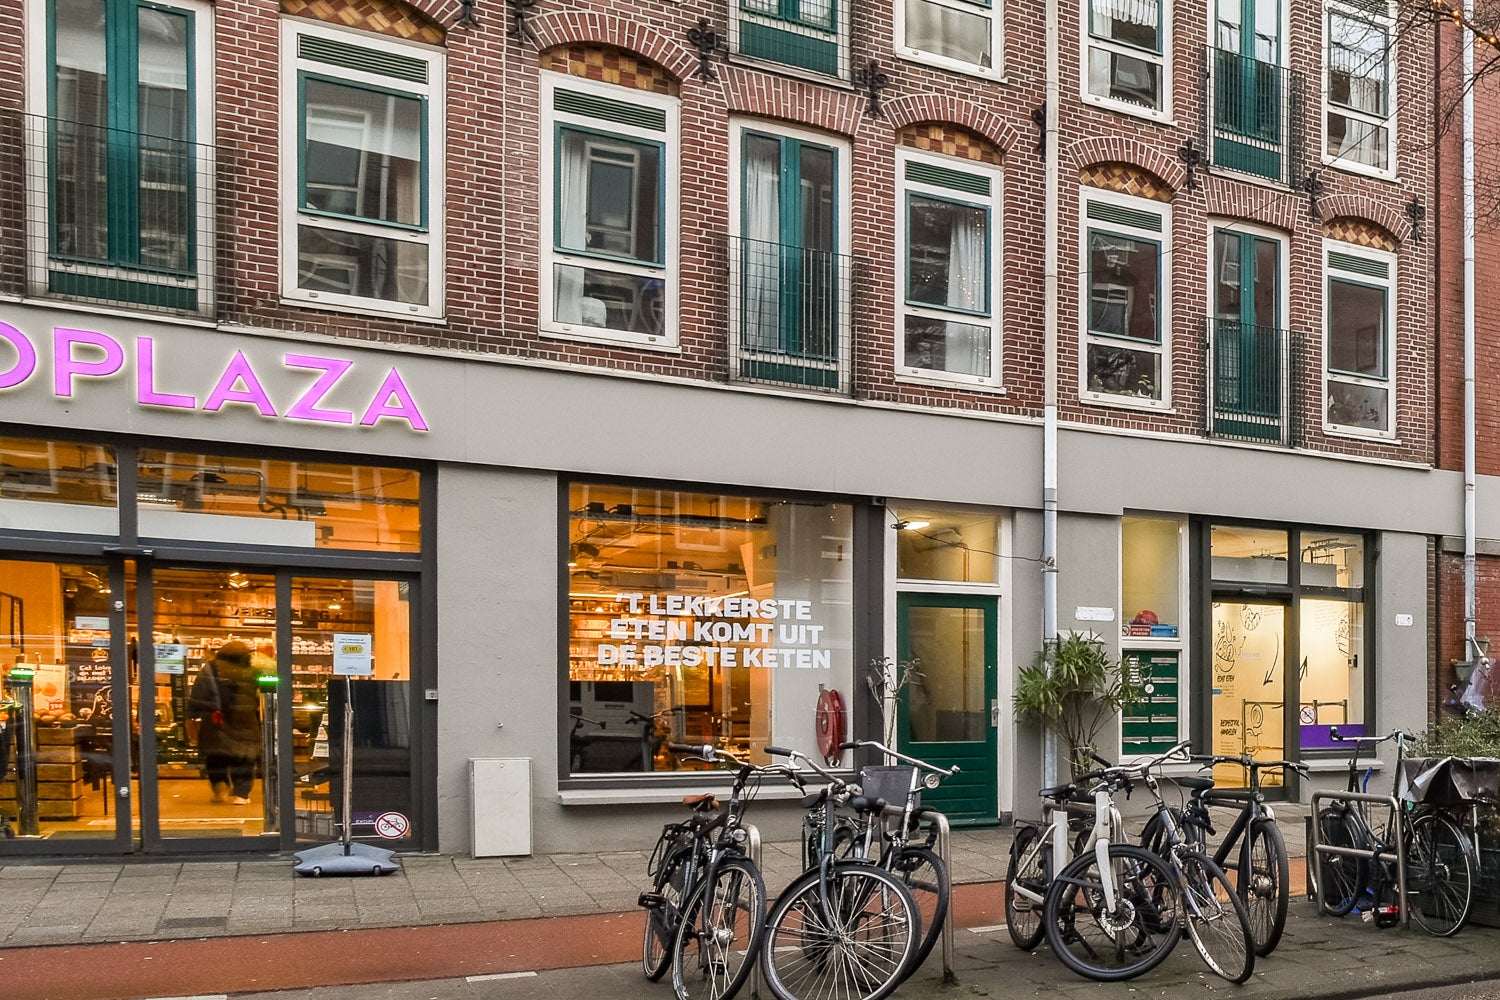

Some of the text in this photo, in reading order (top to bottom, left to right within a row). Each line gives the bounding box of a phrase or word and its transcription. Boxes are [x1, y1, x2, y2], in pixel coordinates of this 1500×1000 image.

[649, 594, 812, 621] LEKKERSTE
[610, 618, 824, 645] ETEN KOMT UIT
[597, 643, 832, 669] DE BESTE KETEN
